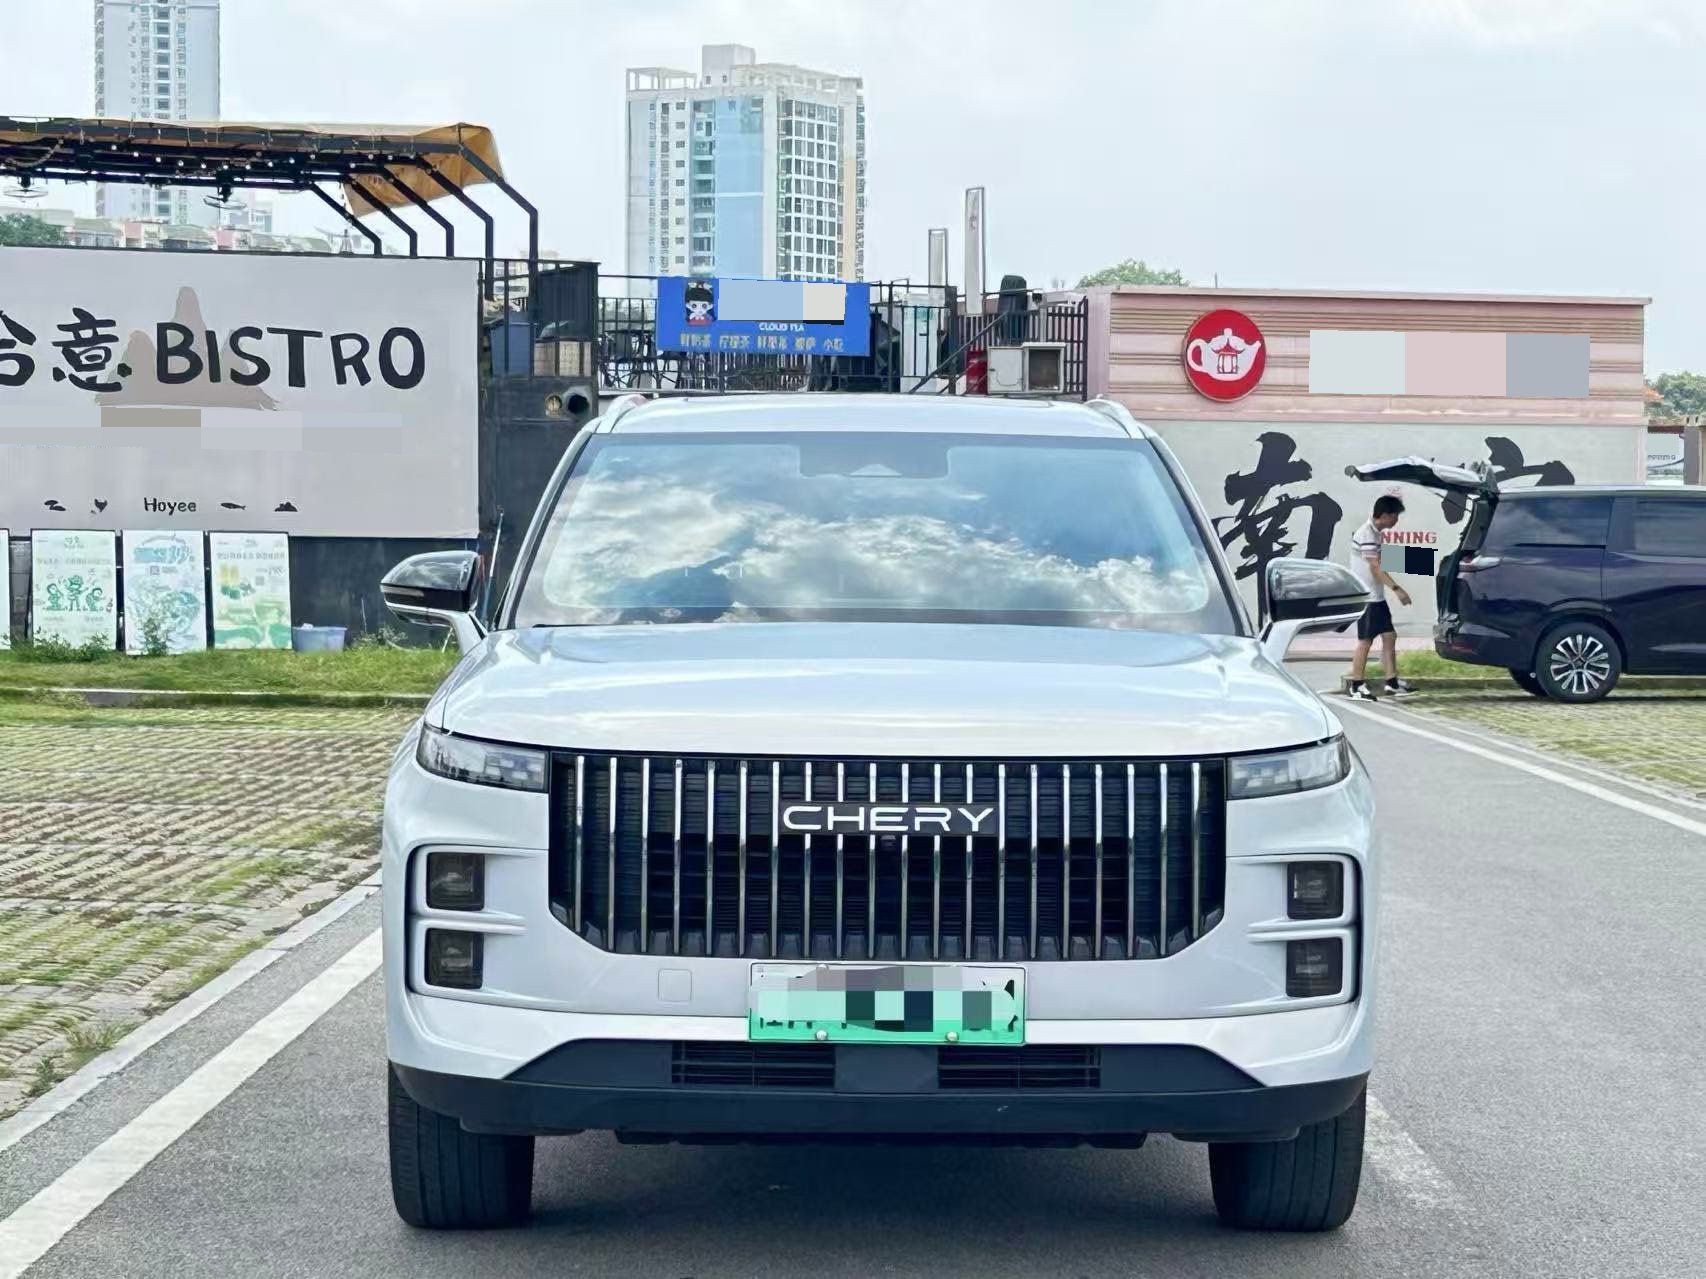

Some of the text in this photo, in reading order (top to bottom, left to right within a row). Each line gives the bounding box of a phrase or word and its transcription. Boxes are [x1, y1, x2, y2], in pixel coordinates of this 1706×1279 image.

[157, 323, 424, 389] BISTRO
[144, 498, 196, 516] Hoyee
[1380, 531, 1437, 544] NNING
[783, 806, 993, 831] CHERY
